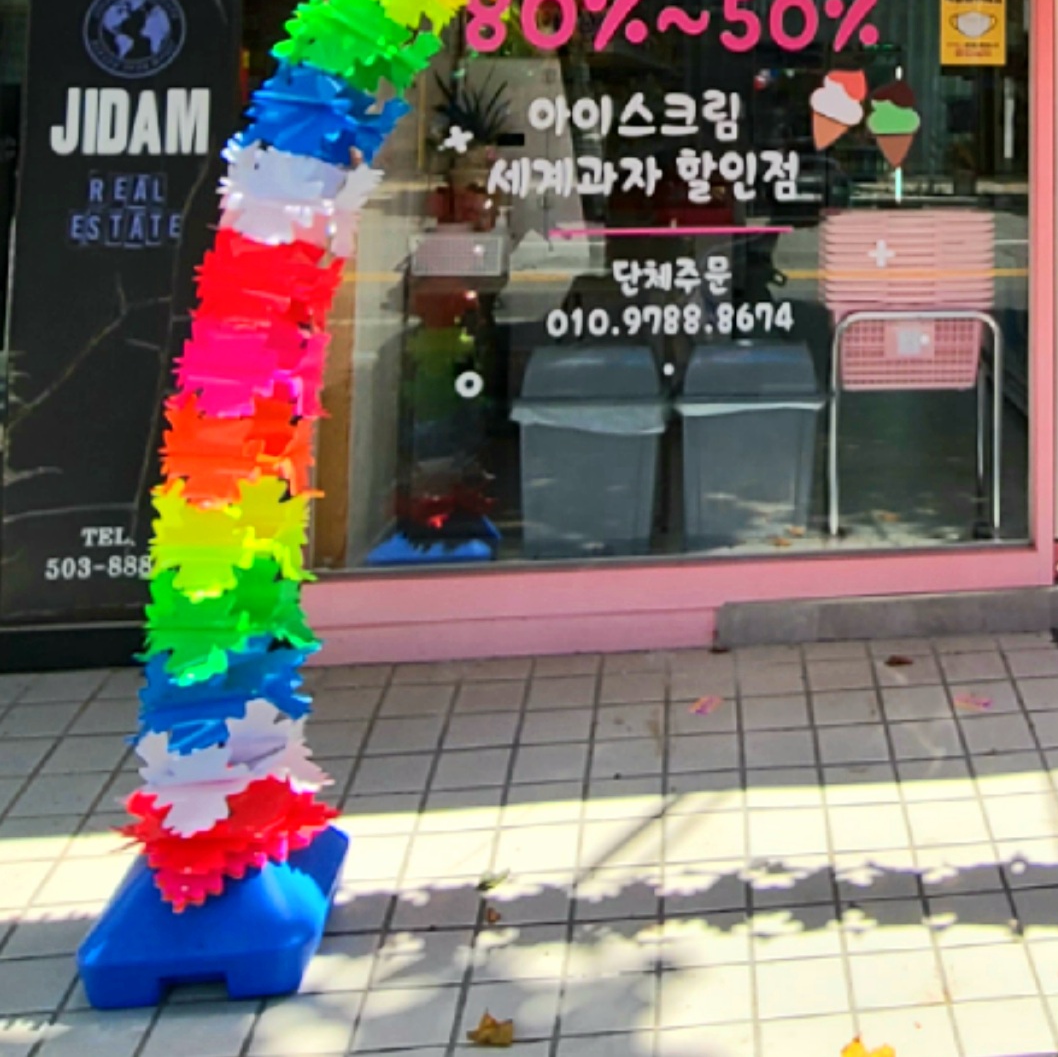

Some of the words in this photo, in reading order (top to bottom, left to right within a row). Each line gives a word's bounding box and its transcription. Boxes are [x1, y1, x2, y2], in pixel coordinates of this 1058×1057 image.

[50, 87, 211, 155] JIDAM
[527, 89, 742, 142] 아이스크림
[89, 175, 165, 204] REAL
[486, 156, 663, 198] 세계과자
[675, 150, 800, 203] 할인점
[70, 212, 182, 241] ESTATE
[612, 255, 733, 297] 단체주문
[546, 301, 795, 337] 010.9788.8674
[80, 526, 136, 547] TEL.
[44, 555, 152, 581] 503-888
